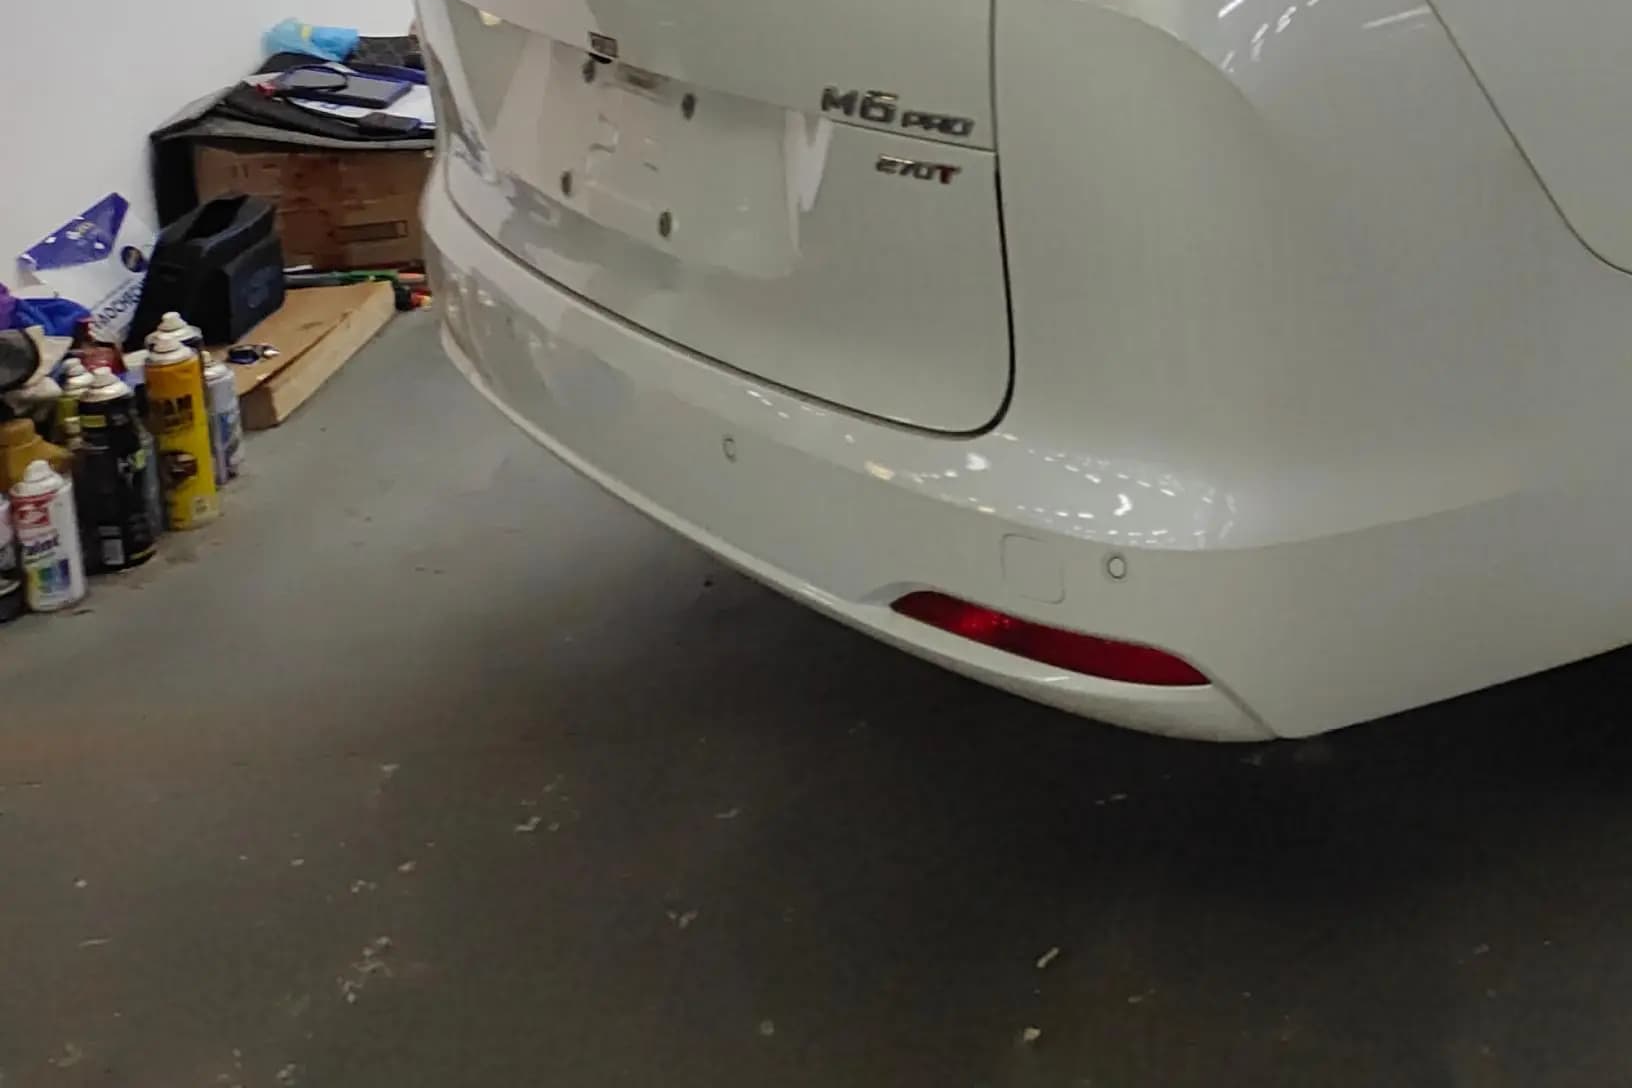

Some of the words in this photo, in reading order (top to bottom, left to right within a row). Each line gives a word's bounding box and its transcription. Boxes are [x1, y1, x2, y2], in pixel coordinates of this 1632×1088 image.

[821, 87, 898, 123] M6
[902, 111, 974, 136] PRO
[876, 154, 961, 184] 270T
